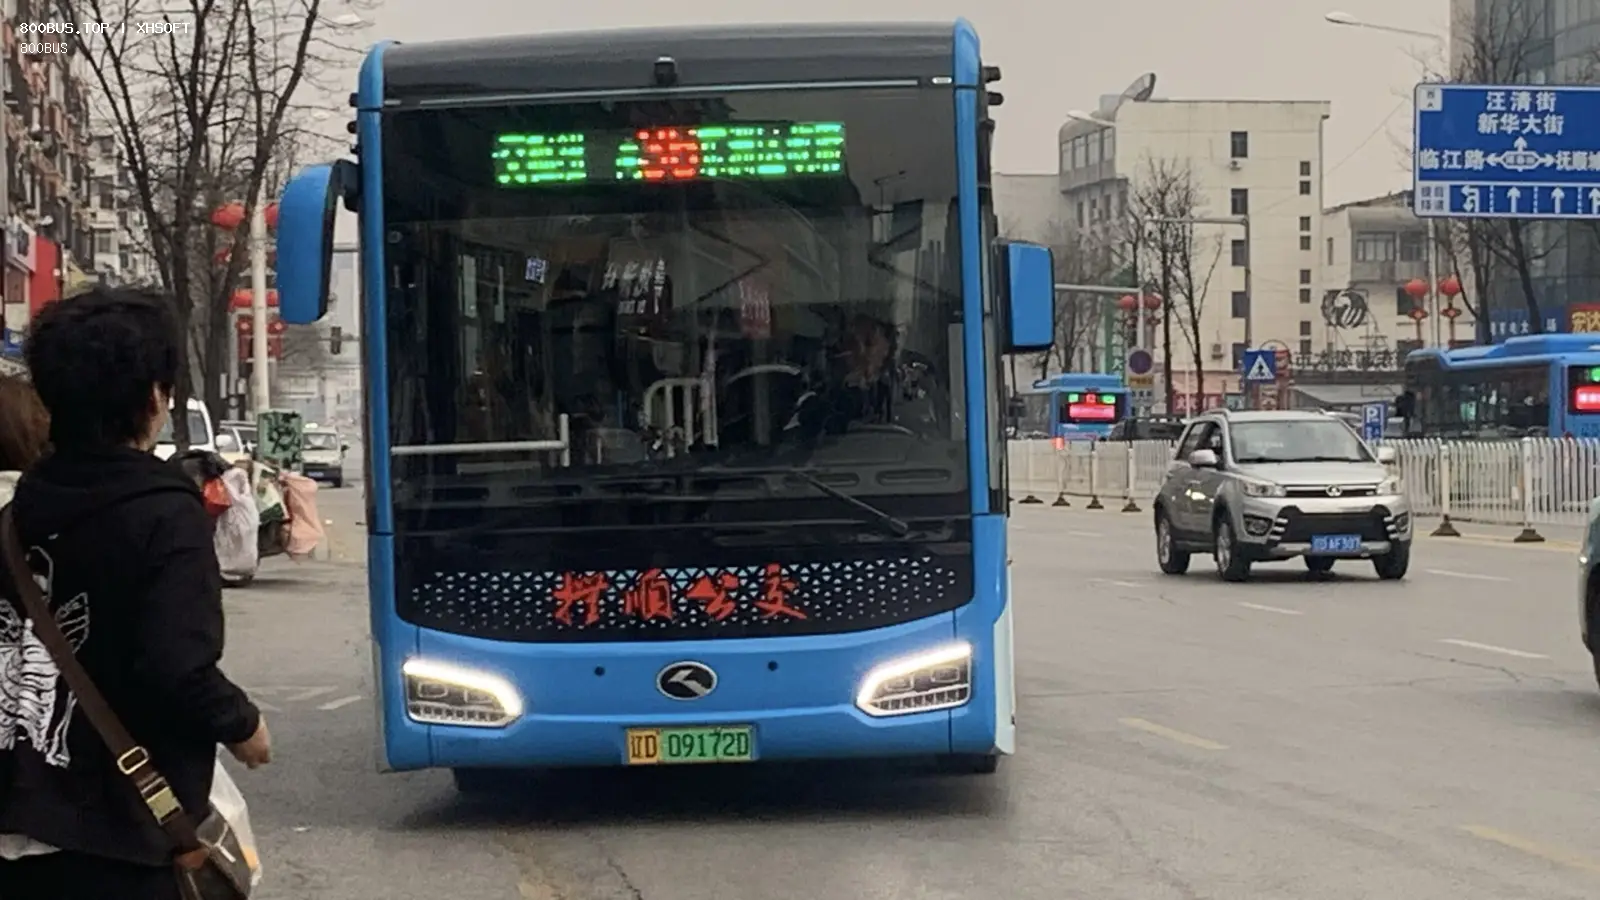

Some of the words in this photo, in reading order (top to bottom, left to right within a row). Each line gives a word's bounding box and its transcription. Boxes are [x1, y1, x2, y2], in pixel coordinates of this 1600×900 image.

[1486, 91, 1556, 112] 汪清街
[1478, 113, 1564, 136] 新华大街
[1420, 148, 1485, 170] 临江路
[1366, 406, 1378, 423] P
[553, 563, 807, 625] 抚顺公交
[630, 734, 657, 759] 辽D
[667, 732, 750, 757] 09172D
